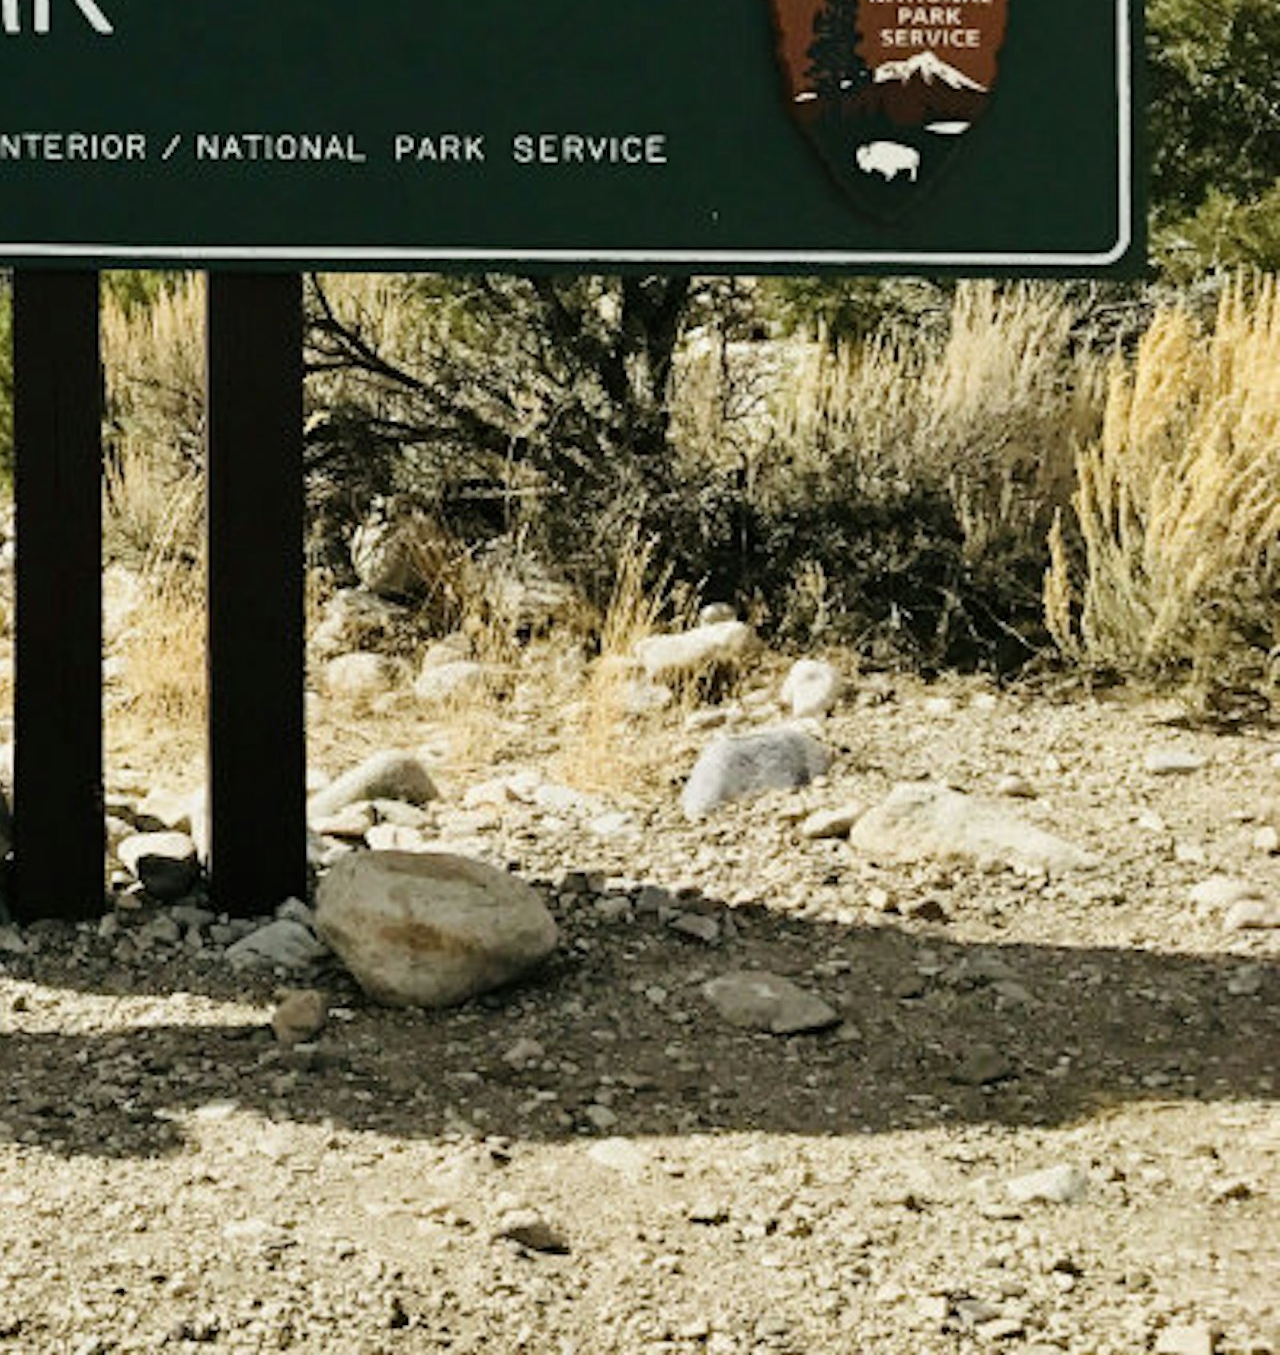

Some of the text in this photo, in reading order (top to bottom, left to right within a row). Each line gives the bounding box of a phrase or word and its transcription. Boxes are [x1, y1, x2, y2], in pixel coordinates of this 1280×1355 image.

[898, 7, 962, 25] PARK
[880, 29, 980, 48] SERVICE
[196, 134, 366, 162] NATIONAL
[395, 134, 485, 162] PARK
[513, 134, 668, 164] SERVICE
